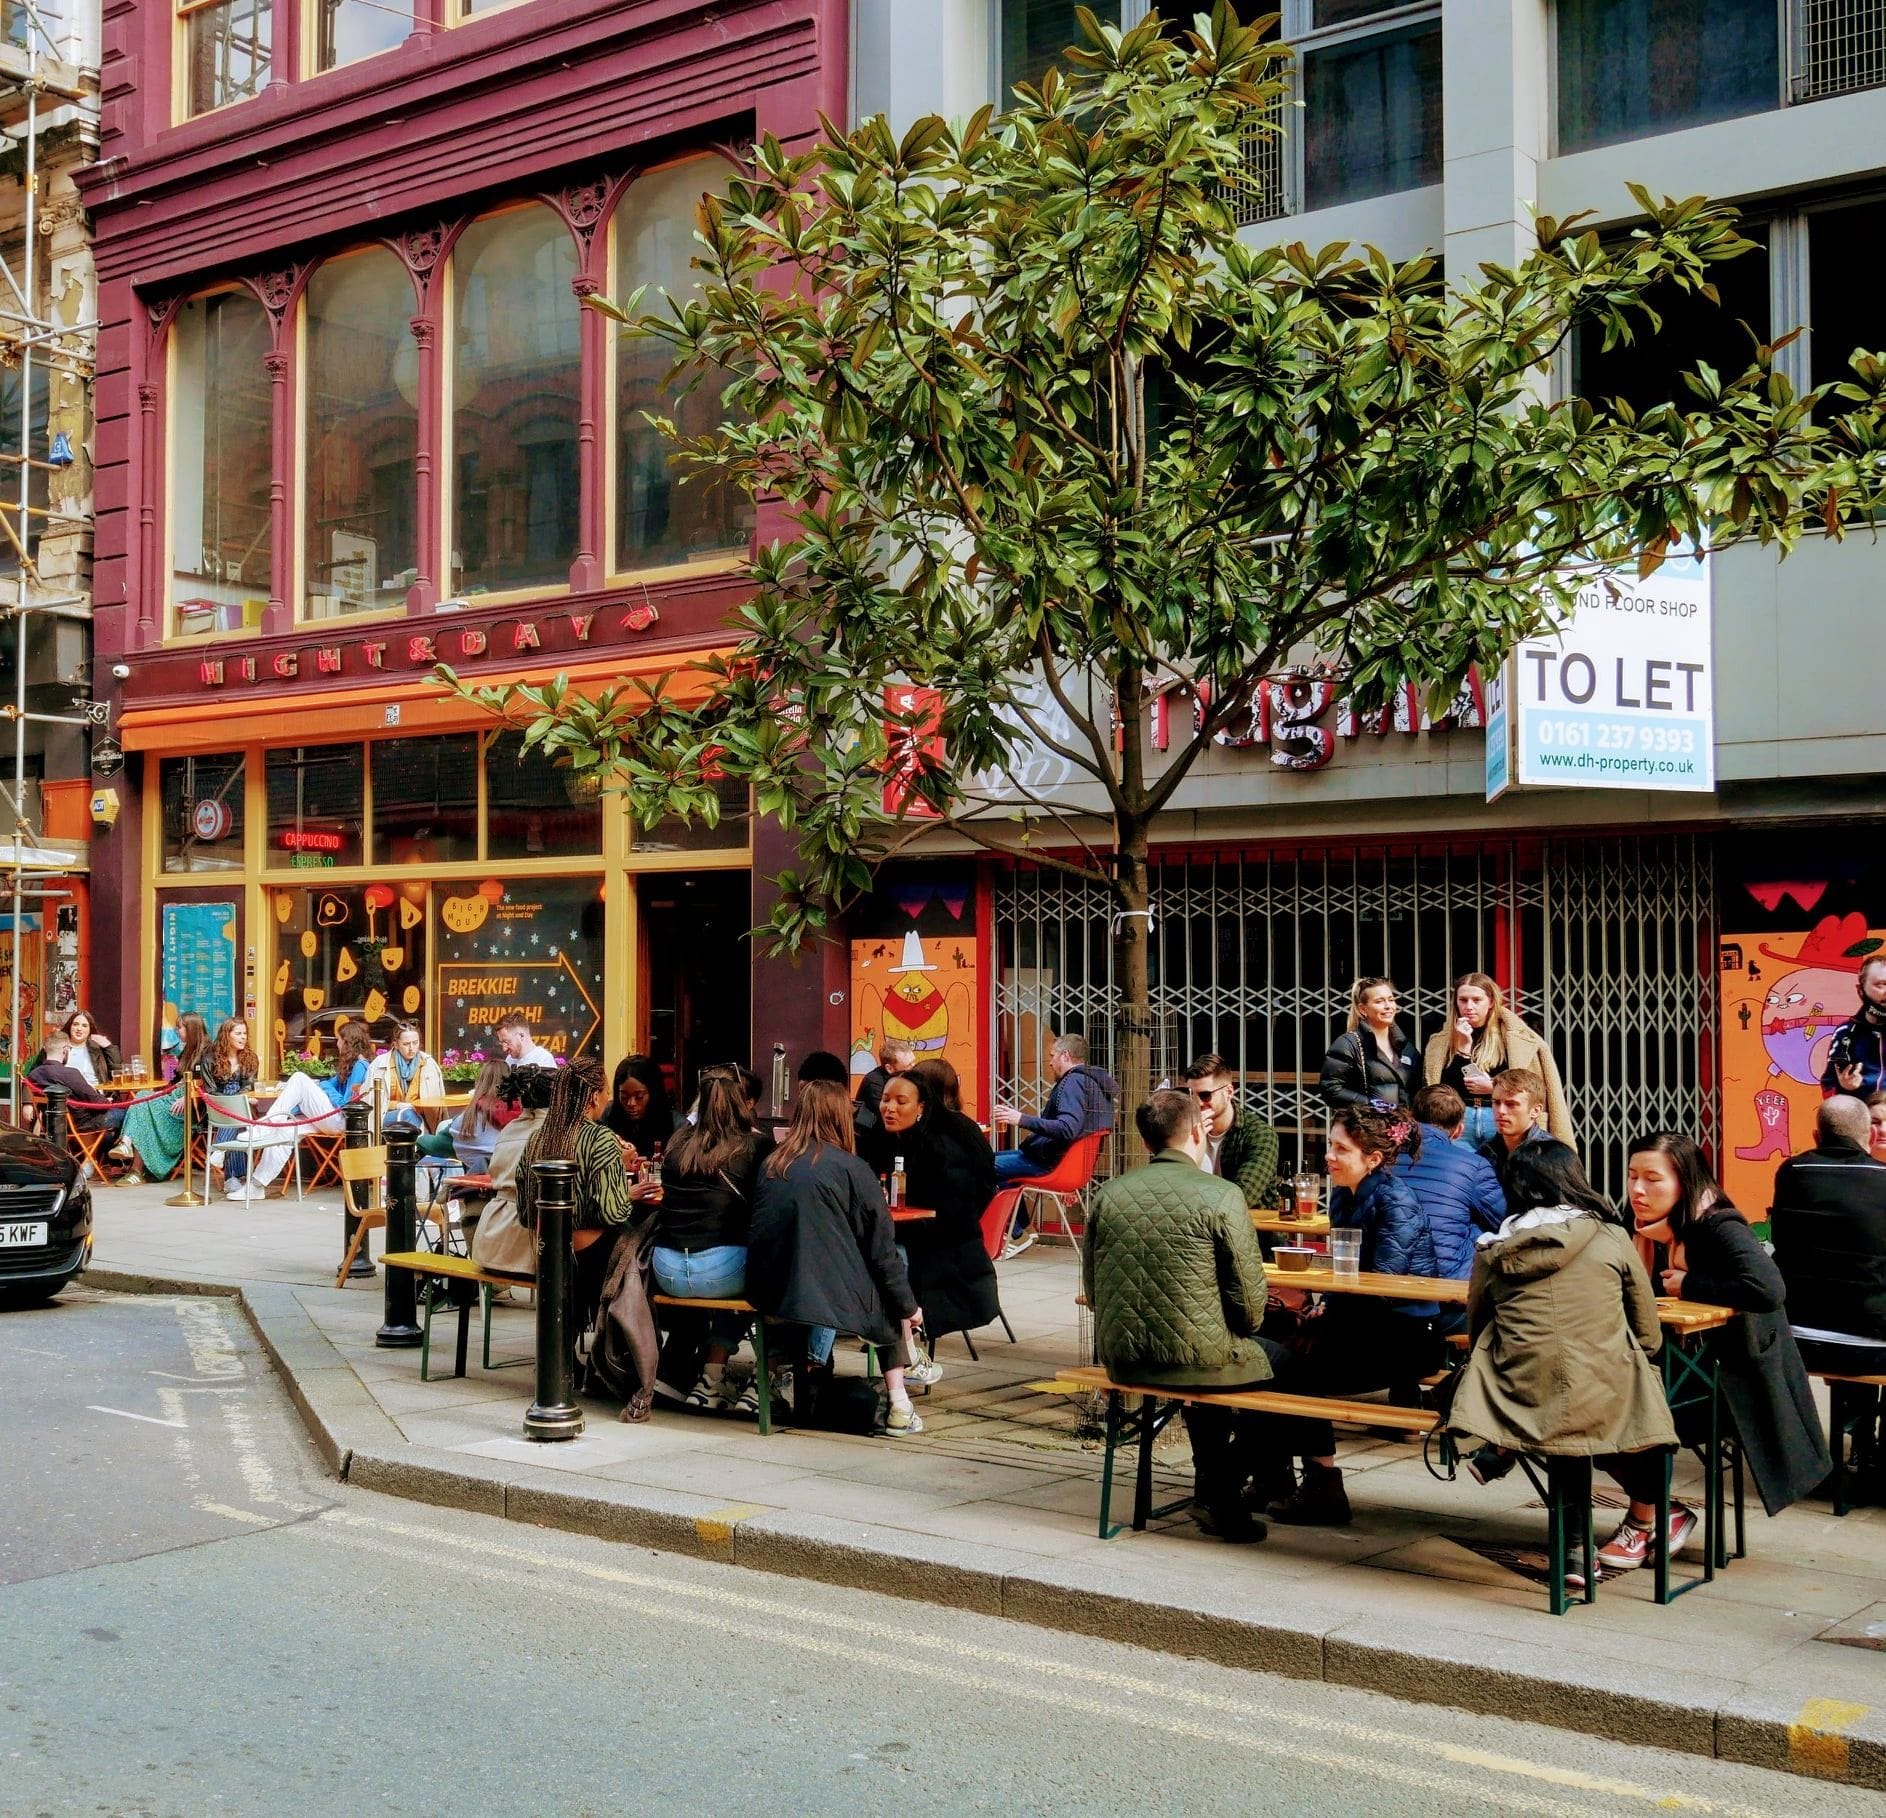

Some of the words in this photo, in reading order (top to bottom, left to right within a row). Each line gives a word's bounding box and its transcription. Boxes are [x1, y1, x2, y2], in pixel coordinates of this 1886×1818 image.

[1660, 600, 1698, 618] SHOP
[1526, 650, 1597, 705] TO
[1616, 657, 1704, 712] LET
[1539, 720, 1590, 746] 0161
[1597, 724, 1636, 749] 237
[1640, 727, 1695, 753] 9393
[1540, 753, 1695, 775] www.dh-property.co.uk
[285, 832, 340, 849] CAPPUCCINO
[291, 855, 335, 868] ESPRESSO
[448, 977, 518, 995] BREKKIE!
[10, 1226, 38, 1242] KWF
